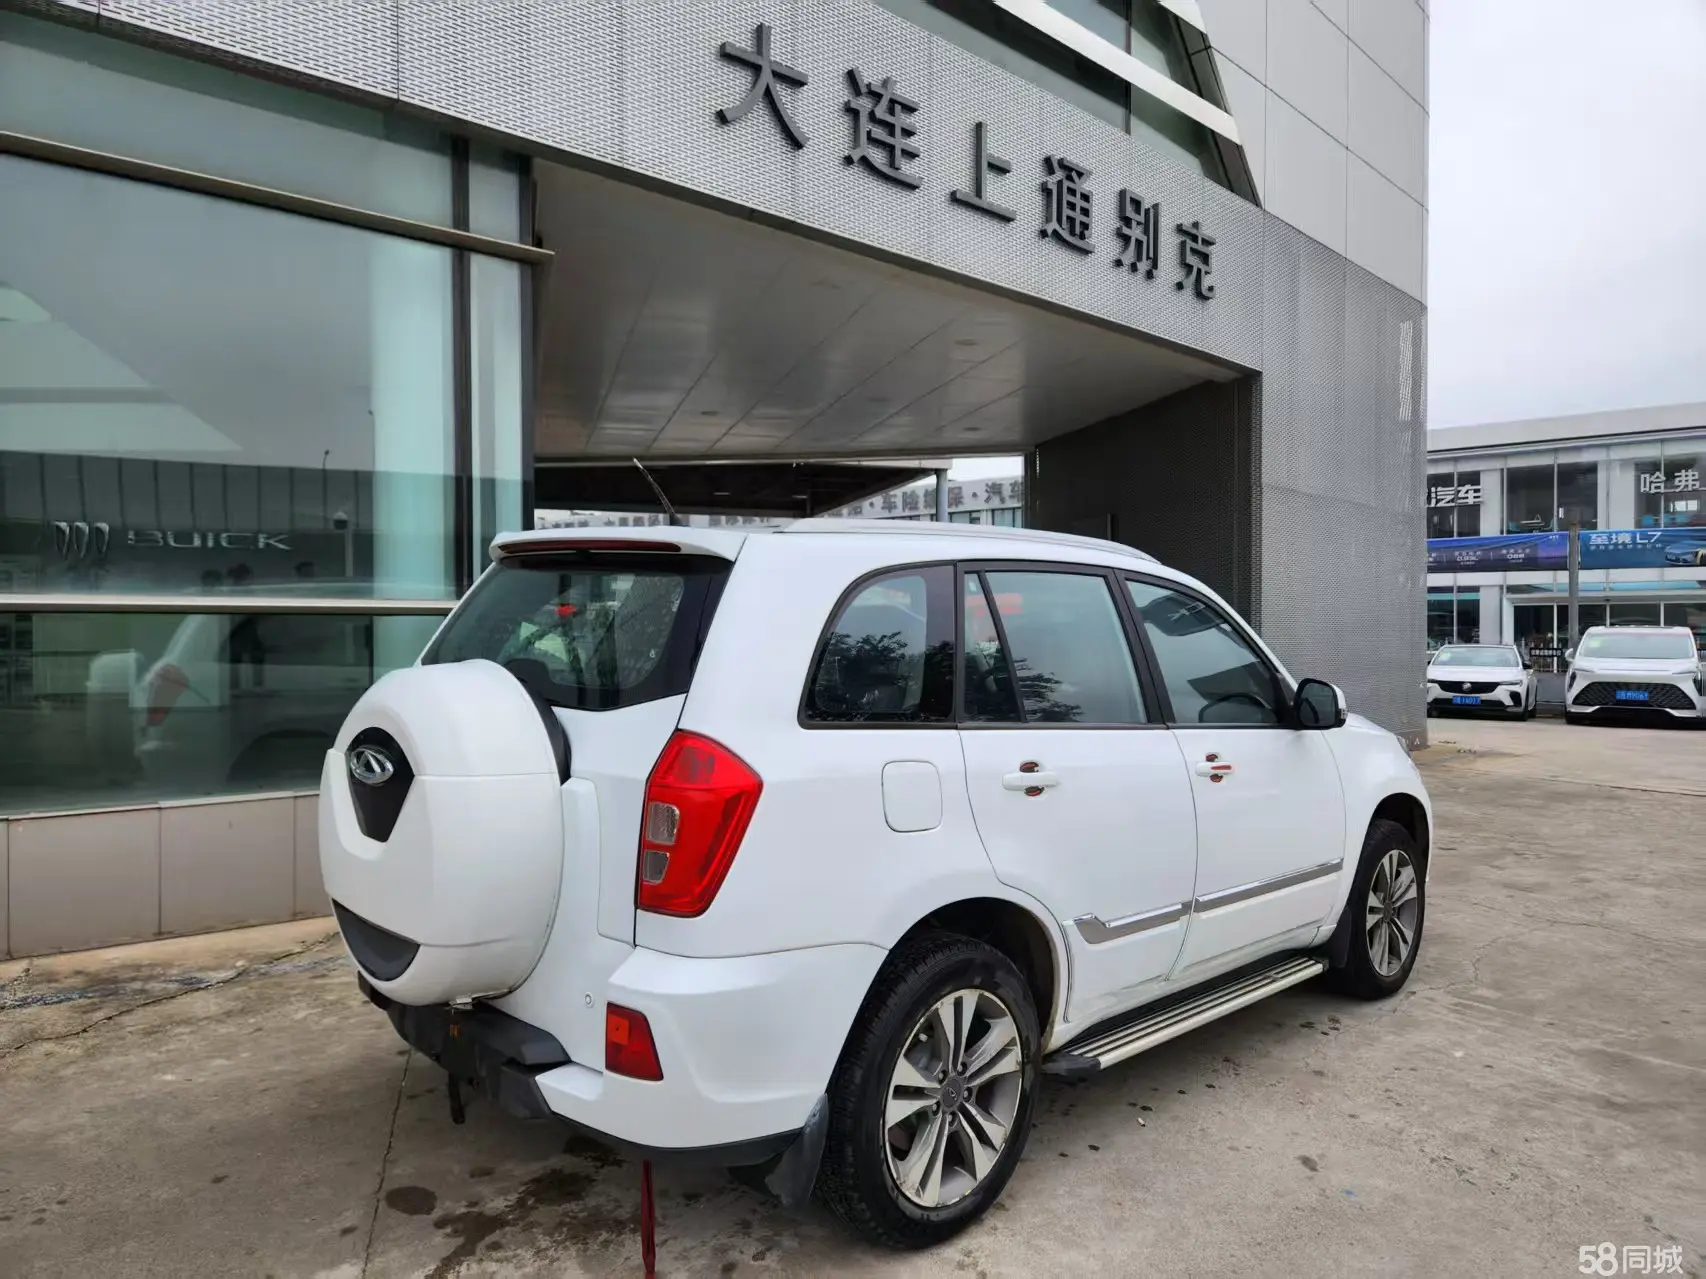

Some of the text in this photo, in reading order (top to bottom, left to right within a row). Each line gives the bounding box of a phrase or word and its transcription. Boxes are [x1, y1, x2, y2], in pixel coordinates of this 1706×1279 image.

[714, 22, 1216, 300] 大连上通别克
[1640, 469, 1700, 493] 哈弗
[127, 530, 293, 550] BUICK
[1636, 532, 1662, 543] L7
